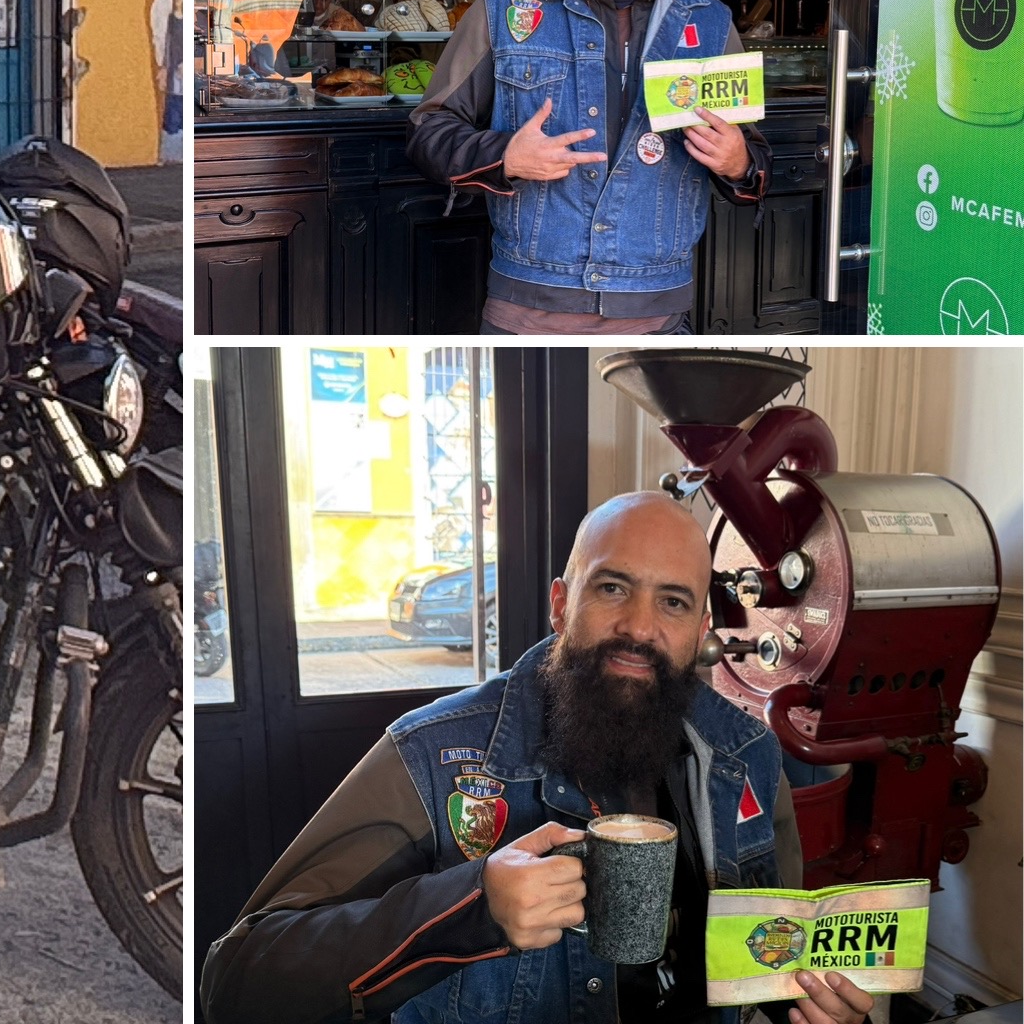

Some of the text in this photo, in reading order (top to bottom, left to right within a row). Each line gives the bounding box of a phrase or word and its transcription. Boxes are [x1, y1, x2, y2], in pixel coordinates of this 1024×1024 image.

[701, 70, 748, 82] MOTOTURISTA
[701, 79, 749, 100] RRM
[950, 195, 1024, 228] MCAFEM
[867, 515, 880, 527] NO
[448, 749, 471, 760] MOTO
[469, 786, 491, 797] RRM
[814, 912, 899, 929] MOTOTURISTA
[811, 924, 898, 953] RRM
[810, 953, 861, 968] MÉXICO
